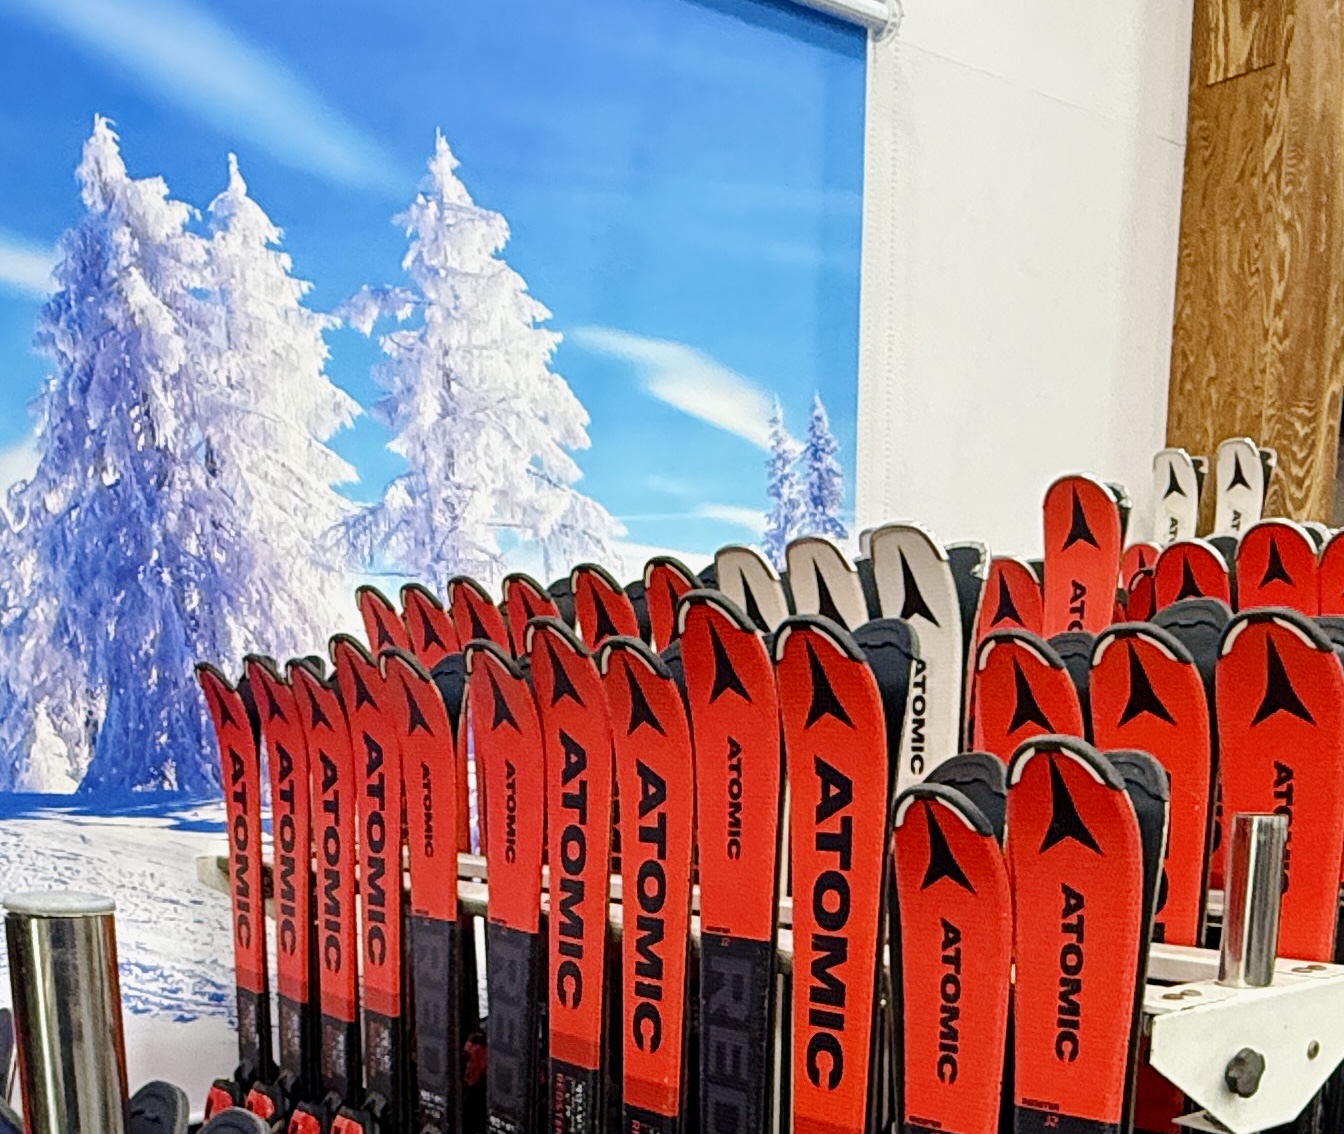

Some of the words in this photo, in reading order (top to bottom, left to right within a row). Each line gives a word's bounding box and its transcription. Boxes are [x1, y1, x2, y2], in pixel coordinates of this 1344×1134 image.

[420, 761, 434, 858] ATOMIC
[505, 759, 516, 864] ATOMIC
[727, 735, 743, 860] ATOMIC
[910, 658, 927, 775] ATOMIC
[228, 746, 251, 950] ATOMIC
[276, 740, 297, 957] ATOMIC
[319, 748, 342, 974] ATOMIC
[363, 730, 386, 967] ATOMIC
[557, 727, 587, 1010] ATOMIC
[633, 758, 667, 1054] ATOMIC
[806, 754, 853, 1091] ATOMIC
[936, 917, 962, 1085] ATOMIC
[1055, 882, 1085, 1063] ATOMIC
